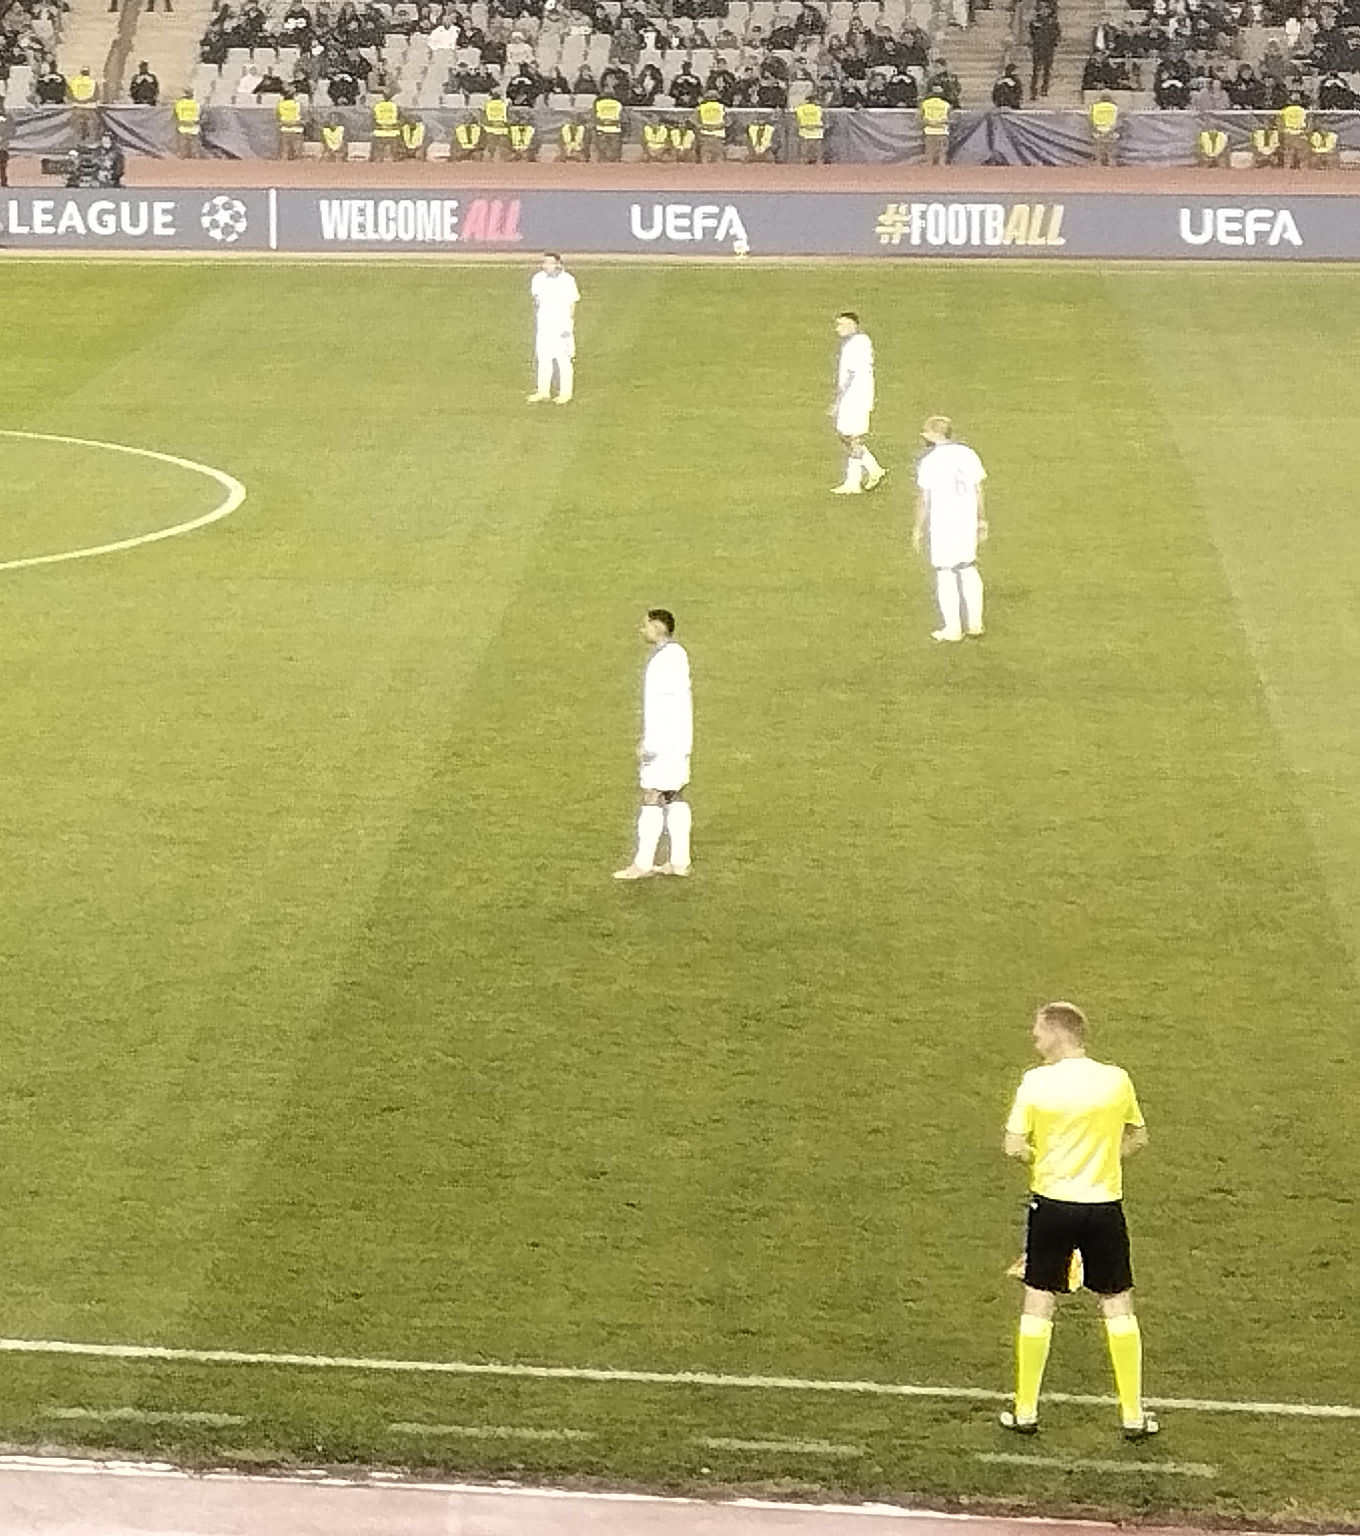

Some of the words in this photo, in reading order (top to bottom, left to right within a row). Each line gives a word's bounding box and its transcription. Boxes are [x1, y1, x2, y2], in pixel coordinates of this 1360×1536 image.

[7, 200, 176, 236] LEAGUE
[319, 199, 458, 241] WELCOME
[460, 199, 523, 241] ALL
[630, 205, 746, 241] UEFA
[875, 203, 1066, 246] #FOOTBALL
[1179, 209, 1303, 246] UEFA
